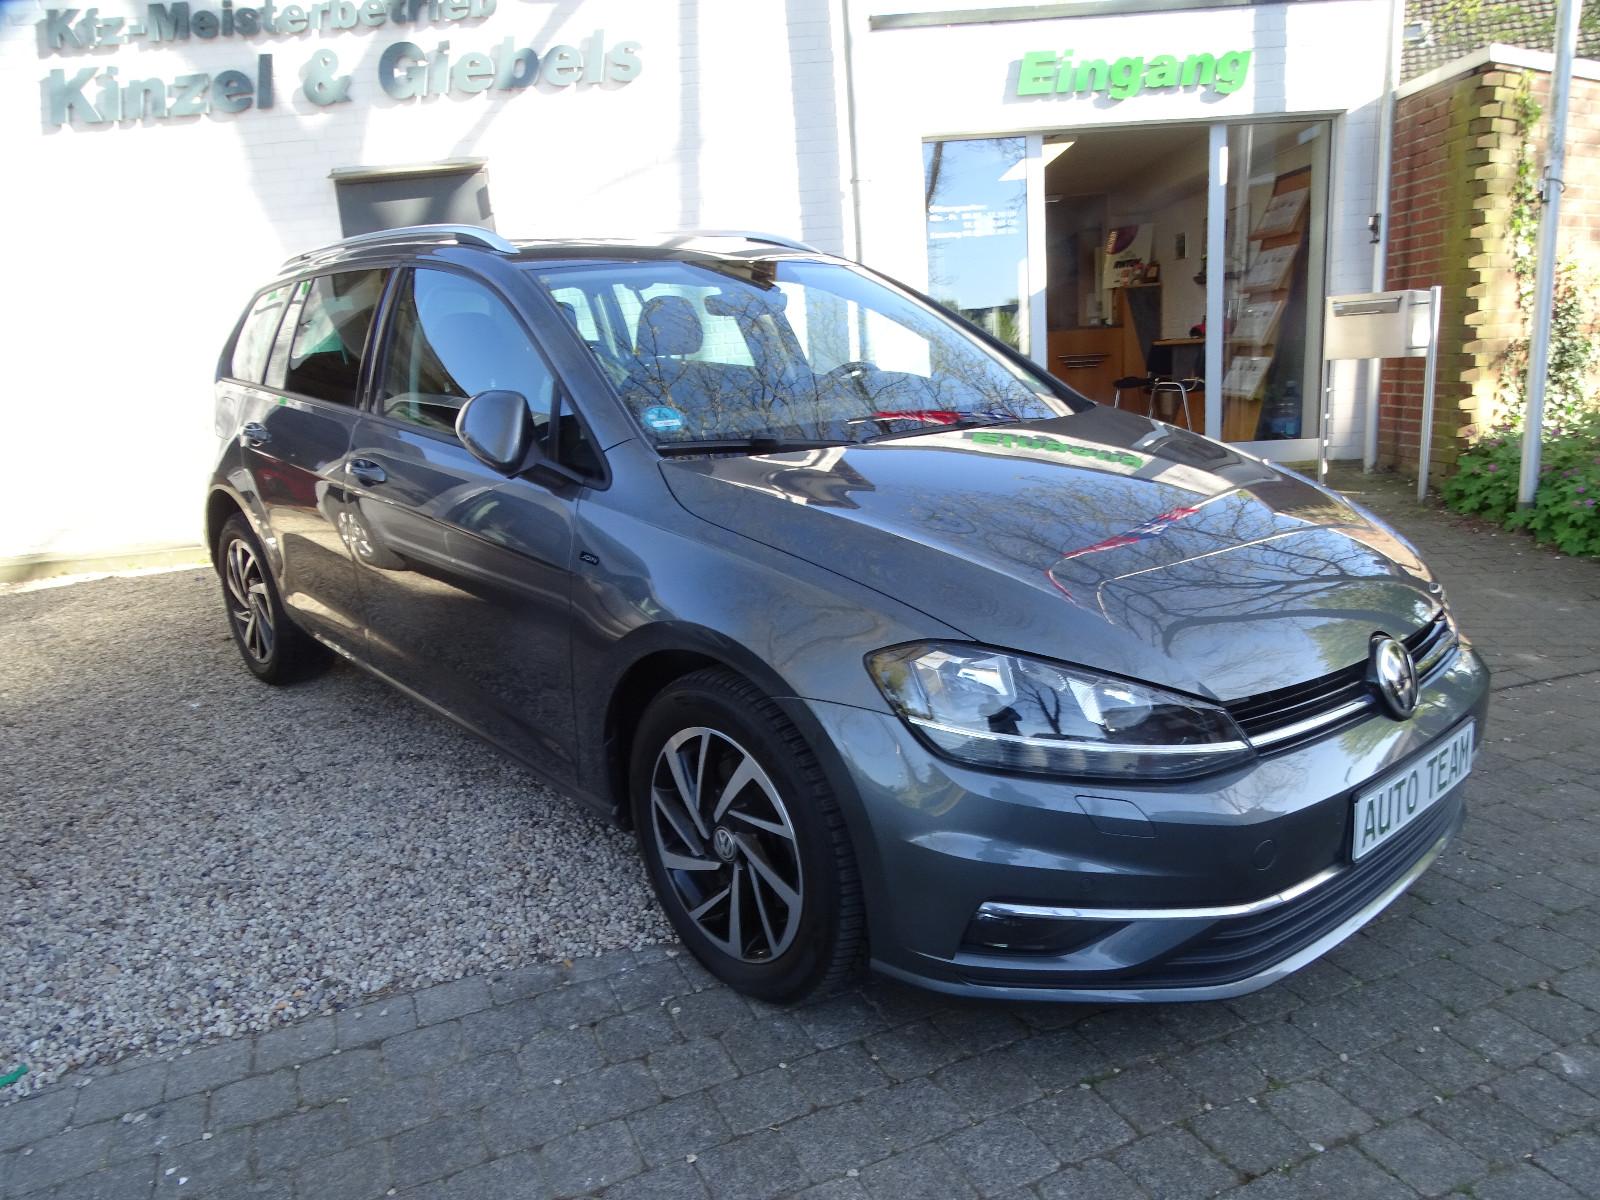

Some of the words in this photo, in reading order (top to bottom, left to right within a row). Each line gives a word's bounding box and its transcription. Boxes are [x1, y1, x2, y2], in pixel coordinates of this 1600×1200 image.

[46, 0, 496, 49] Kfz-Meisterbetrieb
[49, 53, 273, 124] Kinzel
[303, 49, 352, 106] &
[378, 28, 642, 100] Giebels
[1017, 49, 1252, 99] Eingang
[1361, 769, 1418, 848] AUTO
[1426, 730, 1470, 799] TEAM
